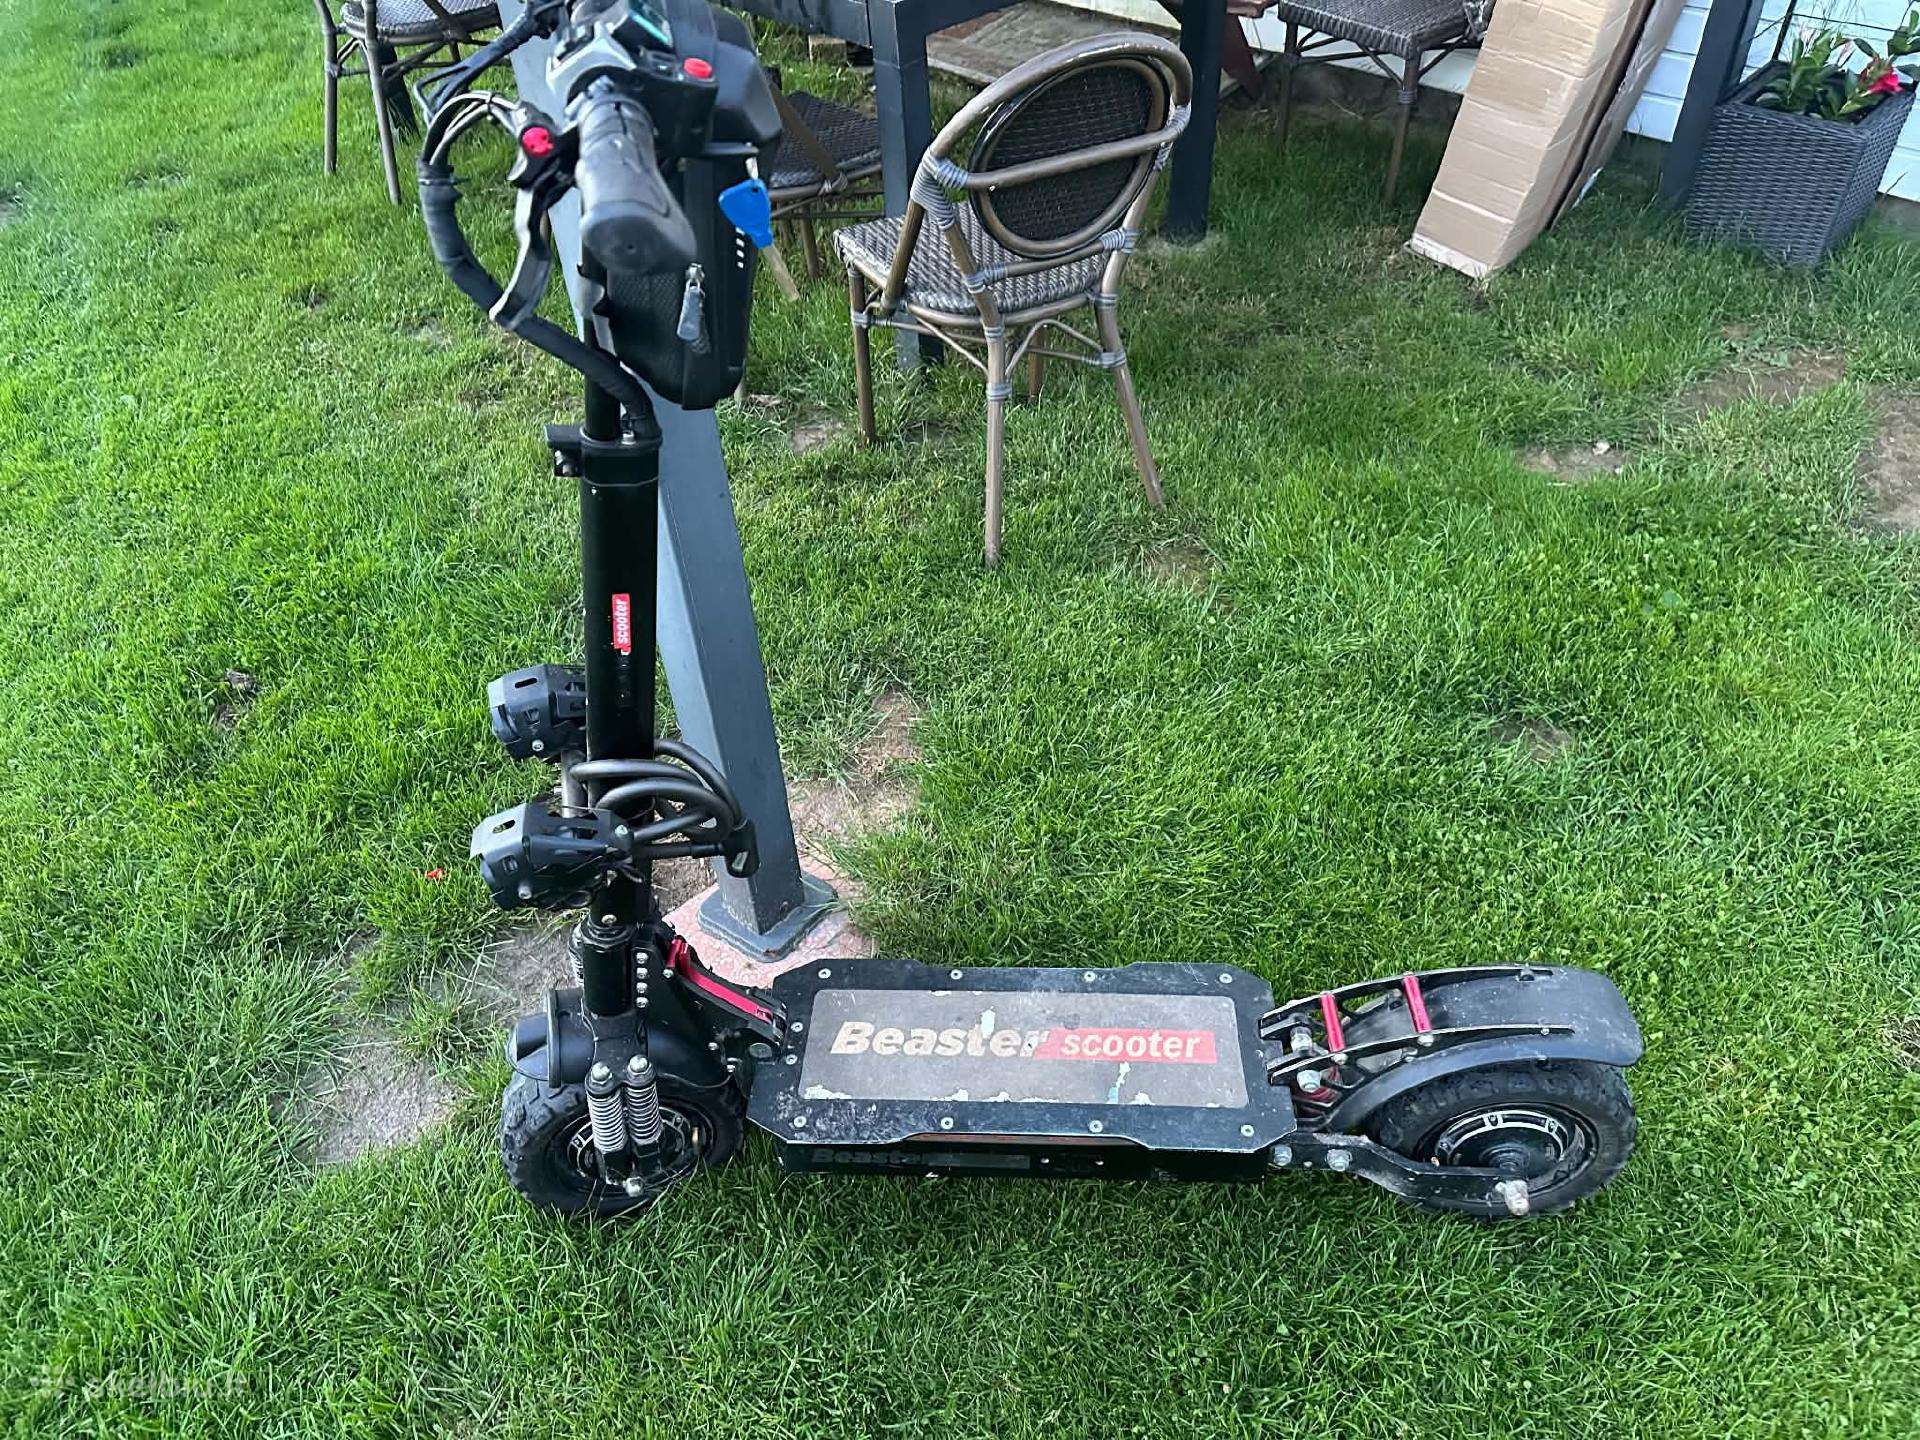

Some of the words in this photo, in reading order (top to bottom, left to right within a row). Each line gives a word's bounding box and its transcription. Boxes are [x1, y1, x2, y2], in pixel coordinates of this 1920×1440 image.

[615, 598, 629, 644] scooter
[830, 1021, 1050, 1057] Beaster
[1063, 1031, 1200, 1058] scooter
